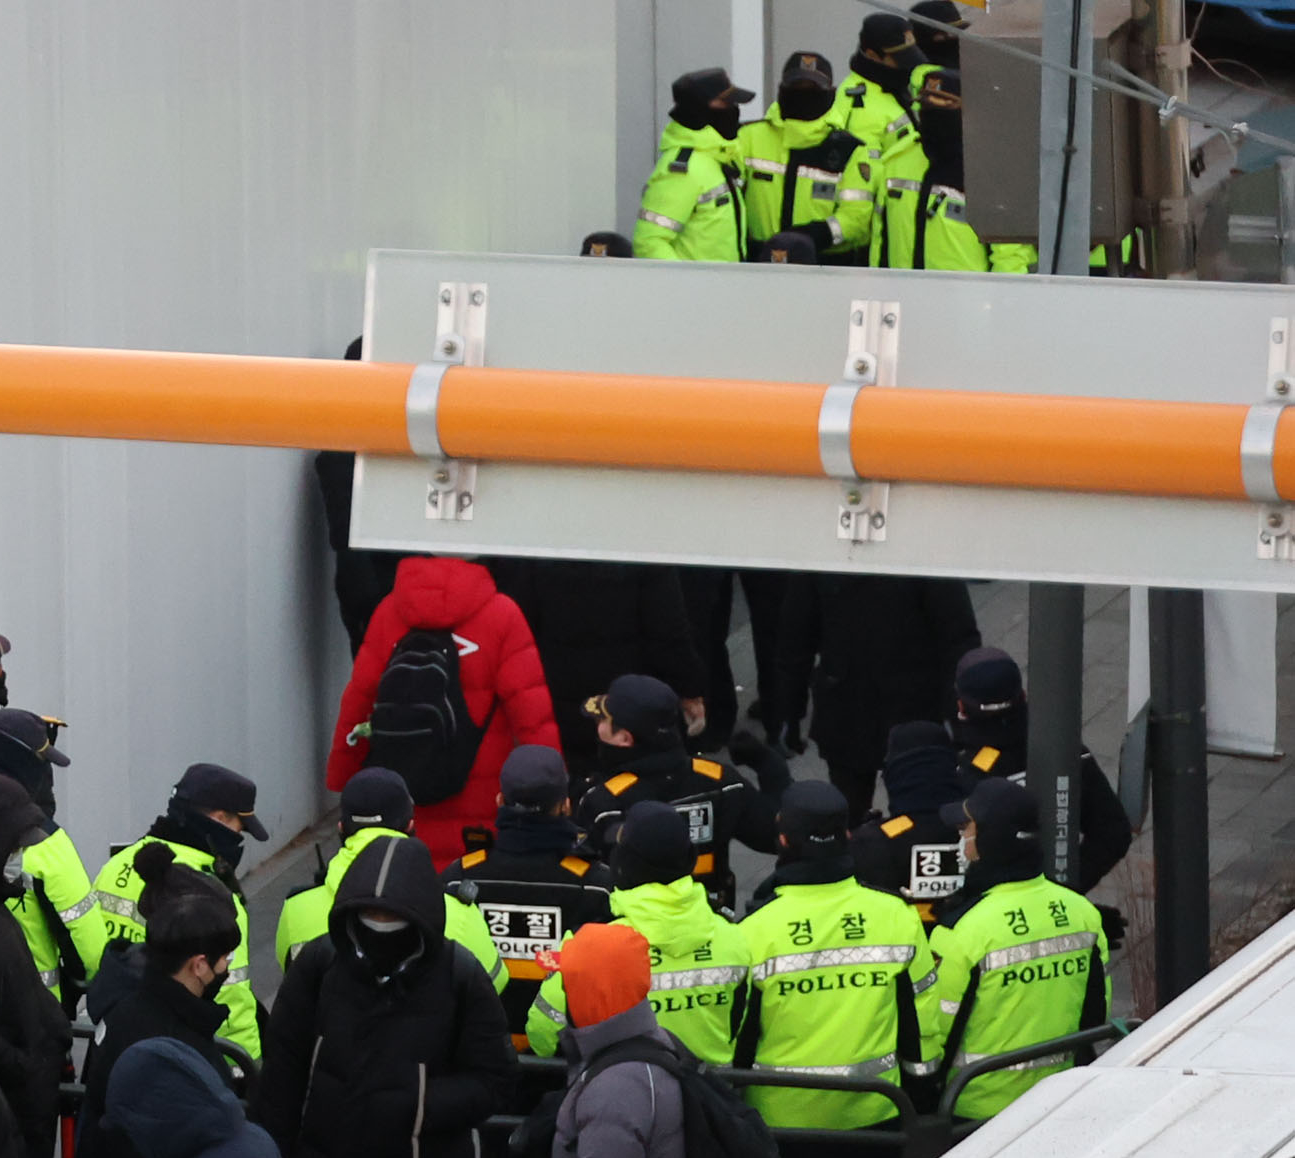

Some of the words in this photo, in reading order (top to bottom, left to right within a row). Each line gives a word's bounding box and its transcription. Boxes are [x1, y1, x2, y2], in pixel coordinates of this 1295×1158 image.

[488, 911, 552, 938] 경찰
[788, 913, 867, 946] 경찰
[1004, 900, 1071, 936] 경찰
[778, 971, 890, 996] POLICE
[1001, 955, 1088, 987] POLICE
[649, 991, 729, 1013] OLICE
